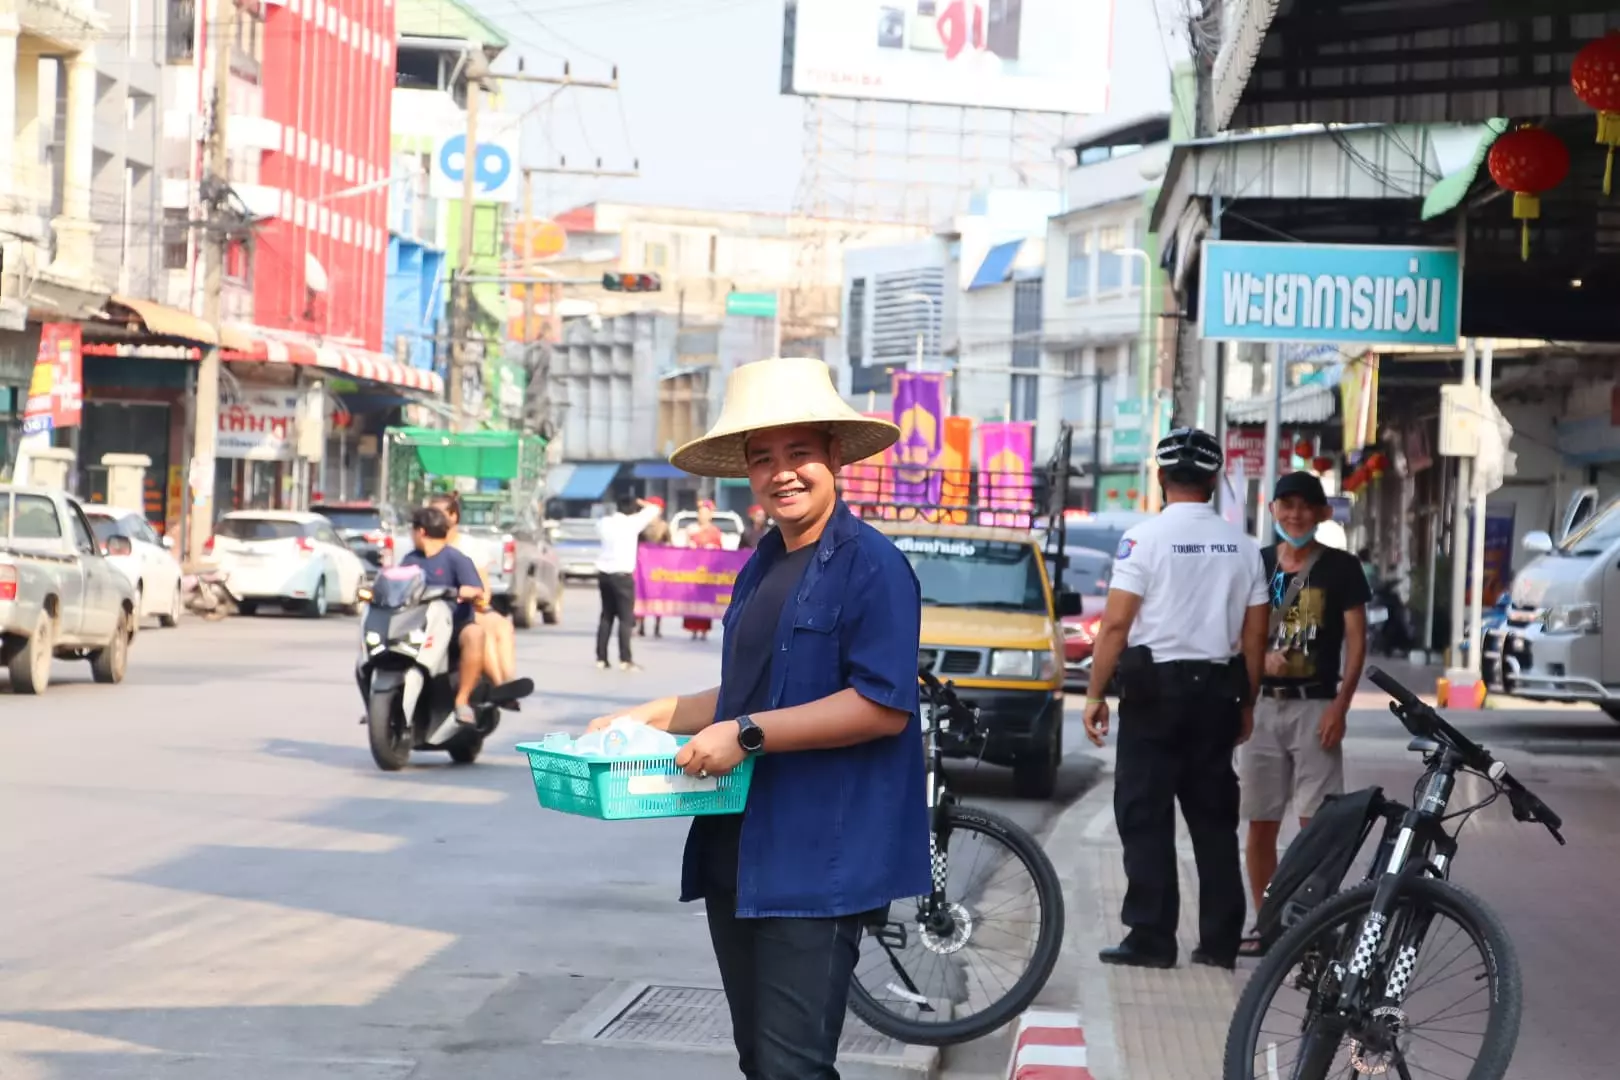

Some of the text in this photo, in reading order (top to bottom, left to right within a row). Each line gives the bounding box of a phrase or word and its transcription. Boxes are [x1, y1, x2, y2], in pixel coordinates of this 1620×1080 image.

[1222, 257, 1441, 333] พะเยาการแว่น
[1171, 544, 1239, 554] TOURIST POLICE
